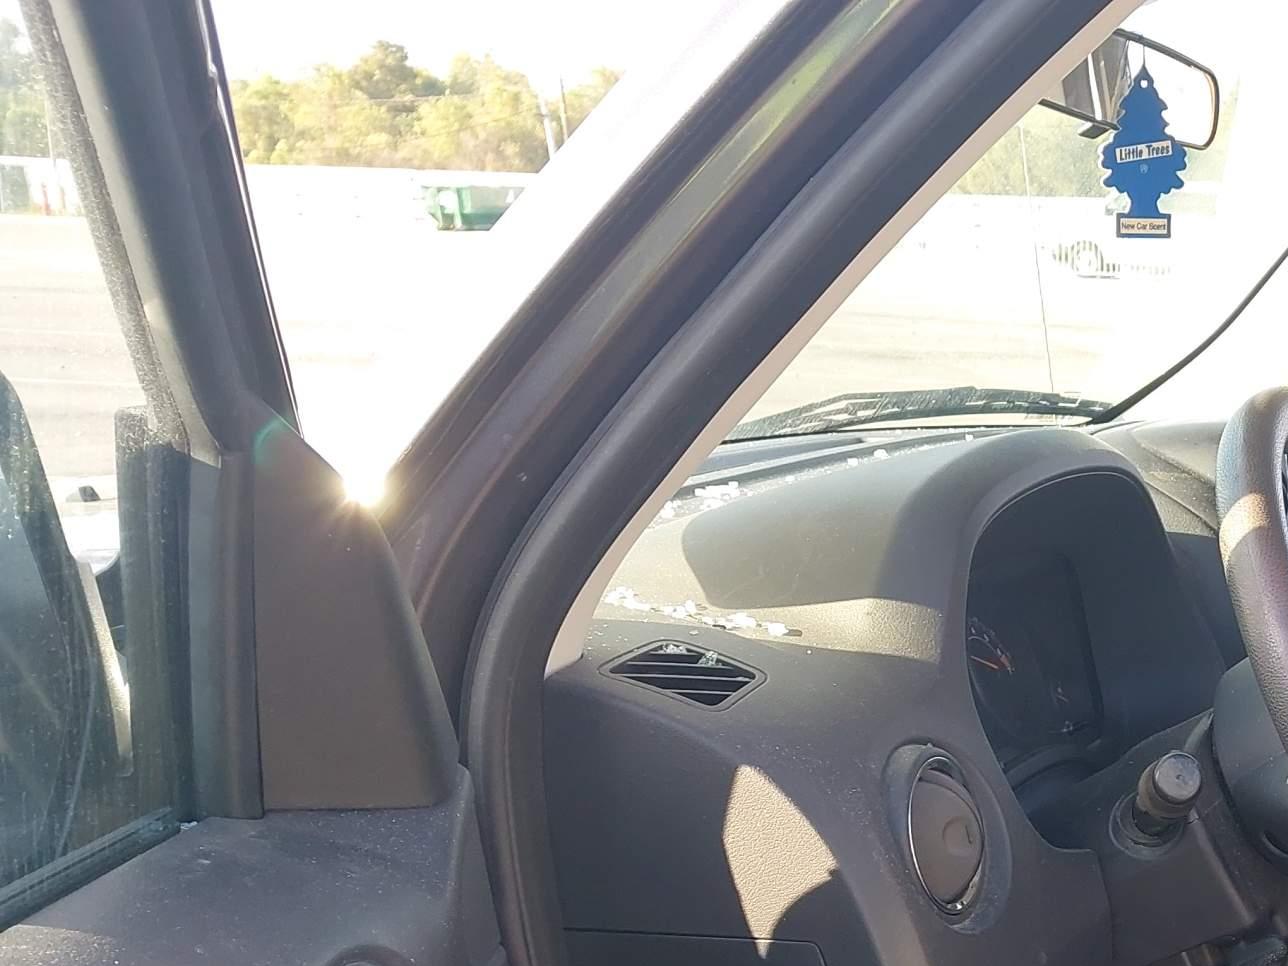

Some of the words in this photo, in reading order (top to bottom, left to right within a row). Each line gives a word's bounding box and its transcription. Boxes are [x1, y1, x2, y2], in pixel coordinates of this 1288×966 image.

[1119, 146, 1144, 161] Little
[1146, 144, 1170, 156] Trees
[1121, 222, 1135, 231] New
[1137, 222, 1148, 231] Car
[1149, 222, 1166, 231] Scent
